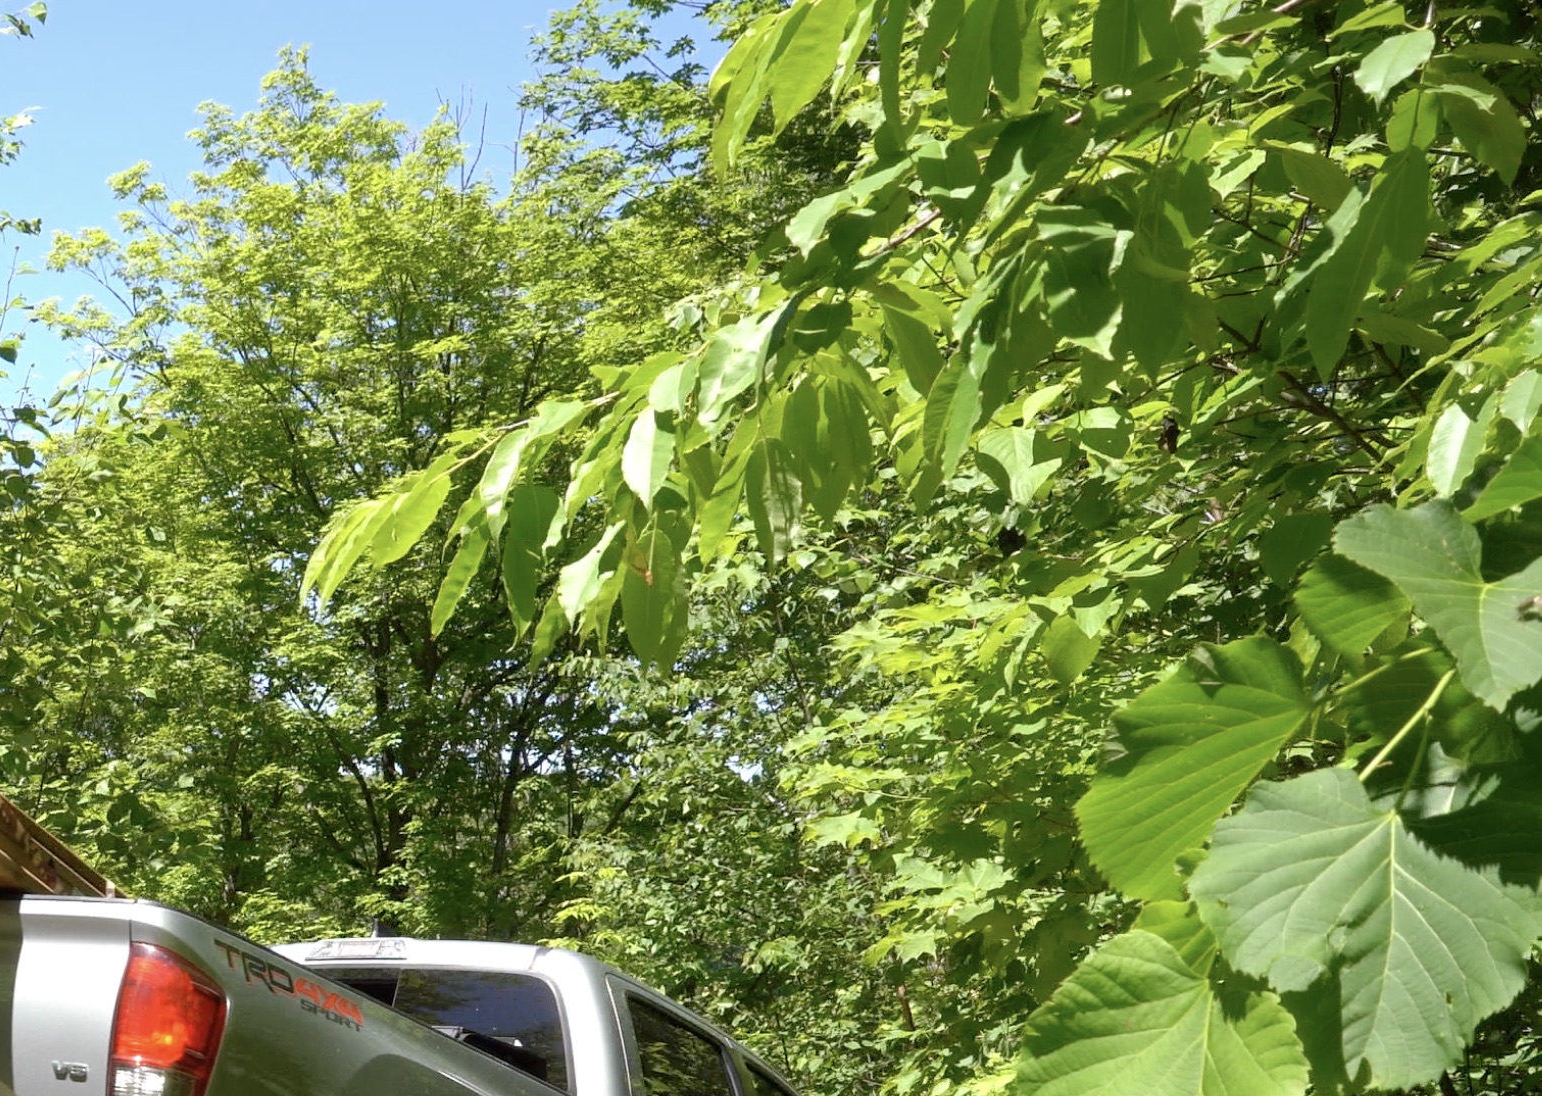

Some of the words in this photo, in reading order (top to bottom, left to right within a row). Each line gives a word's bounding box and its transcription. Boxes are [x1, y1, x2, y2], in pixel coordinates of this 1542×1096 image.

[214, 938, 296, 998] TRD
[300, 997, 363, 1032] SPORT
[51, 1060, 89, 1083] V6
